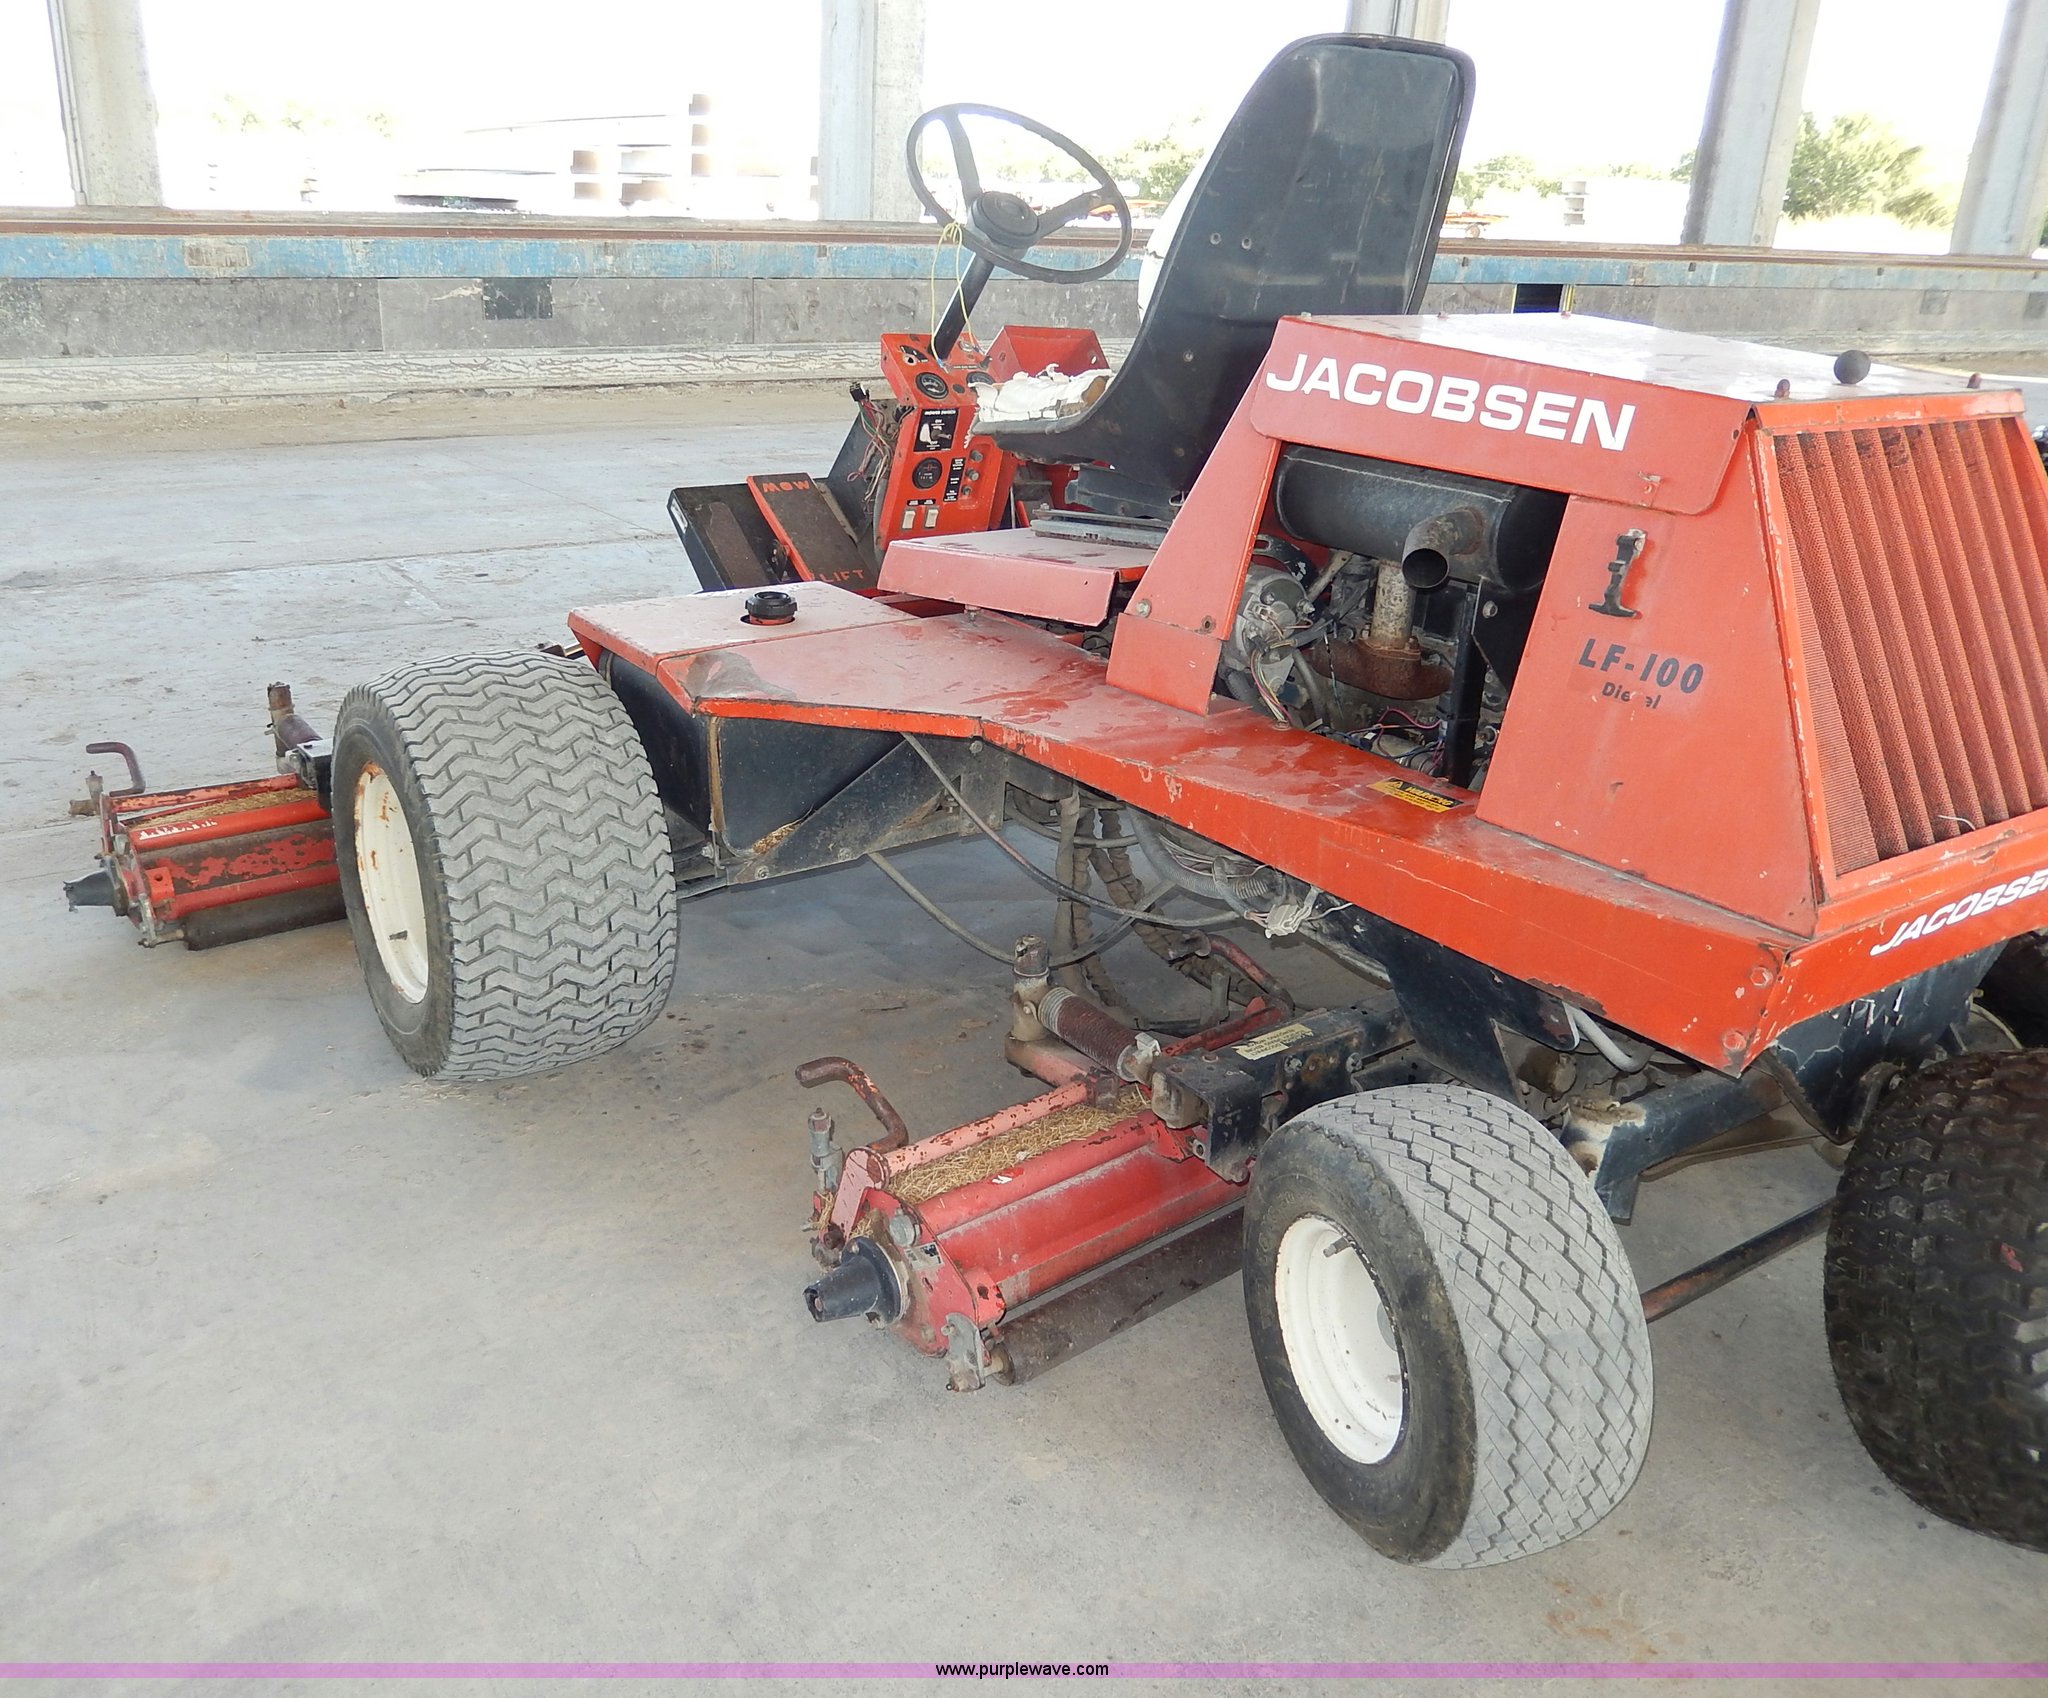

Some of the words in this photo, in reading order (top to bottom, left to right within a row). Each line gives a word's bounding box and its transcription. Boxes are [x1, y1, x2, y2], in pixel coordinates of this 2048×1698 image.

[1265, 353, 1636, 452] JACOBSEN
[762, 480, 811, 493] MOW
[819, 569, 864, 582] LIFT
[1578, 638, 1704, 694] LF-100
[1602, 681, 1662, 709] Dieel
[1869, 867, 2048, 957] JACOBSE
